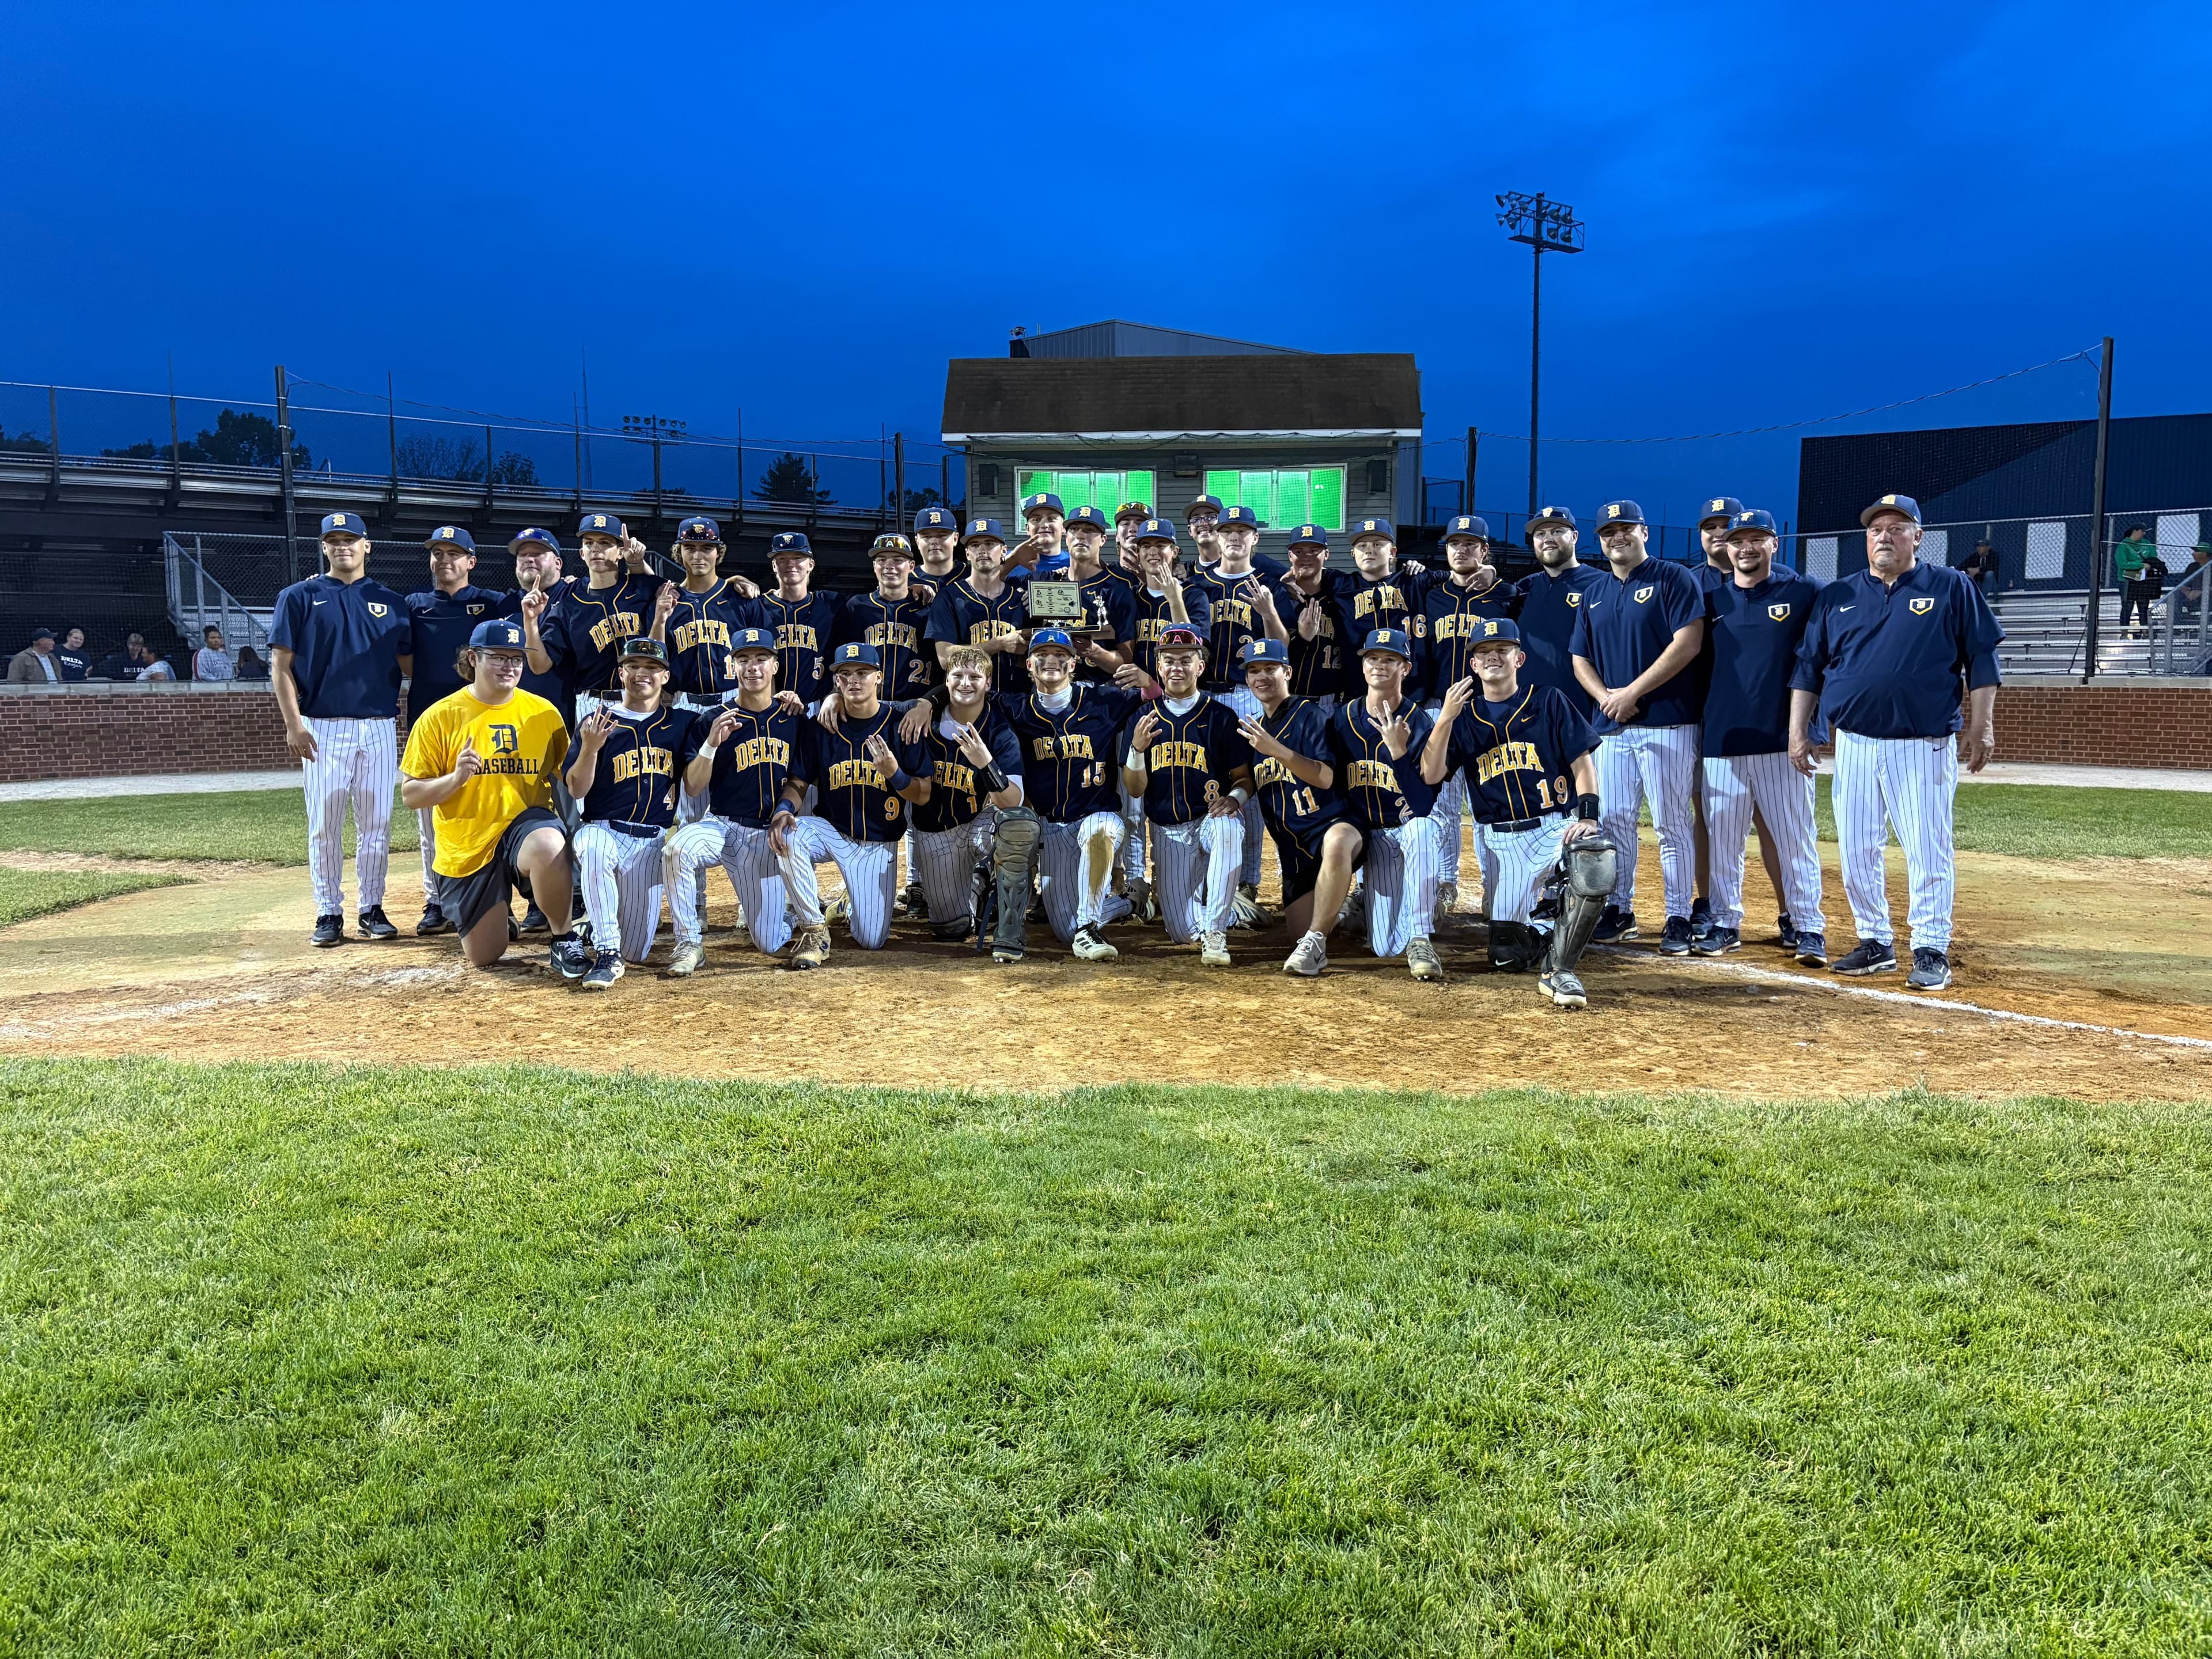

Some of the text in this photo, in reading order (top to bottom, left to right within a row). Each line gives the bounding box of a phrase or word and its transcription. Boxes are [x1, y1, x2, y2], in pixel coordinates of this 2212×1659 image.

[1036, 494, 1047, 505] D
[1608, 505, 1620, 518] D
[1712, 499, 1724, 512] D
[333, 514, 346, 526] D
[594, 516, 607, 527] D
[930, 512, 941, 524] D
[1080, 507, 1091, 517] D
[1229, 507, 1240, 519] D
[1458, 517, 1470, 529] D
[442, 528, 454, 539] D
[976, 521, 987, 532] D
[1147, 520, 1158, 532] D
[1301, 526, 1313, 537] D
[1364, 520, 1376, 531] D
[1354, 586, 1408, 620] DELTA
[507, 629, 520, 644] D
[674, 619, 732, 654] DELTA
[745, 630, 759, 642] D
[774, 624, 818, 652] ELTA
[864, 622, 918, 654] DELTA
[1137, 619, 1172, 644] ELT
[1377, 631, 1391, 643] D
[1402, 614, 1427, 640] 16
[1435, 613, 1487, 643] DELT
[1484, 622, 1498, 636] D
[847, 645, 859, 658] D
[1253, 642, 1266, 655] D
[1323, 645, 1342, 669] 12
[812, 656, 824, 680] 5
[908, 659, 932, 685] 21
[488, 725, 518, 754] D
[1033, 734, 1094, 761] DELTA
[613, 747, 674, 783] DELTA
[734, 737, 789, 772] DELTA
[1151, 741, 1209, 774] DELTA
[1476, 742, 1544, 785] DELTA
[829, 759, 887, 791] DELTA
[931, 761, 976, 796] ELTA
[1081, 762, 1106, 788] 15
[1347, 760, 1402, 794] DELTA
[663, 783, 675, 810] 4
[1203, 780, 1219, 802] 8
[1292, 787, 1320, 816] 11
[1537, 775, 1568, 809] 19
[885, 796, 899, 820] 9
